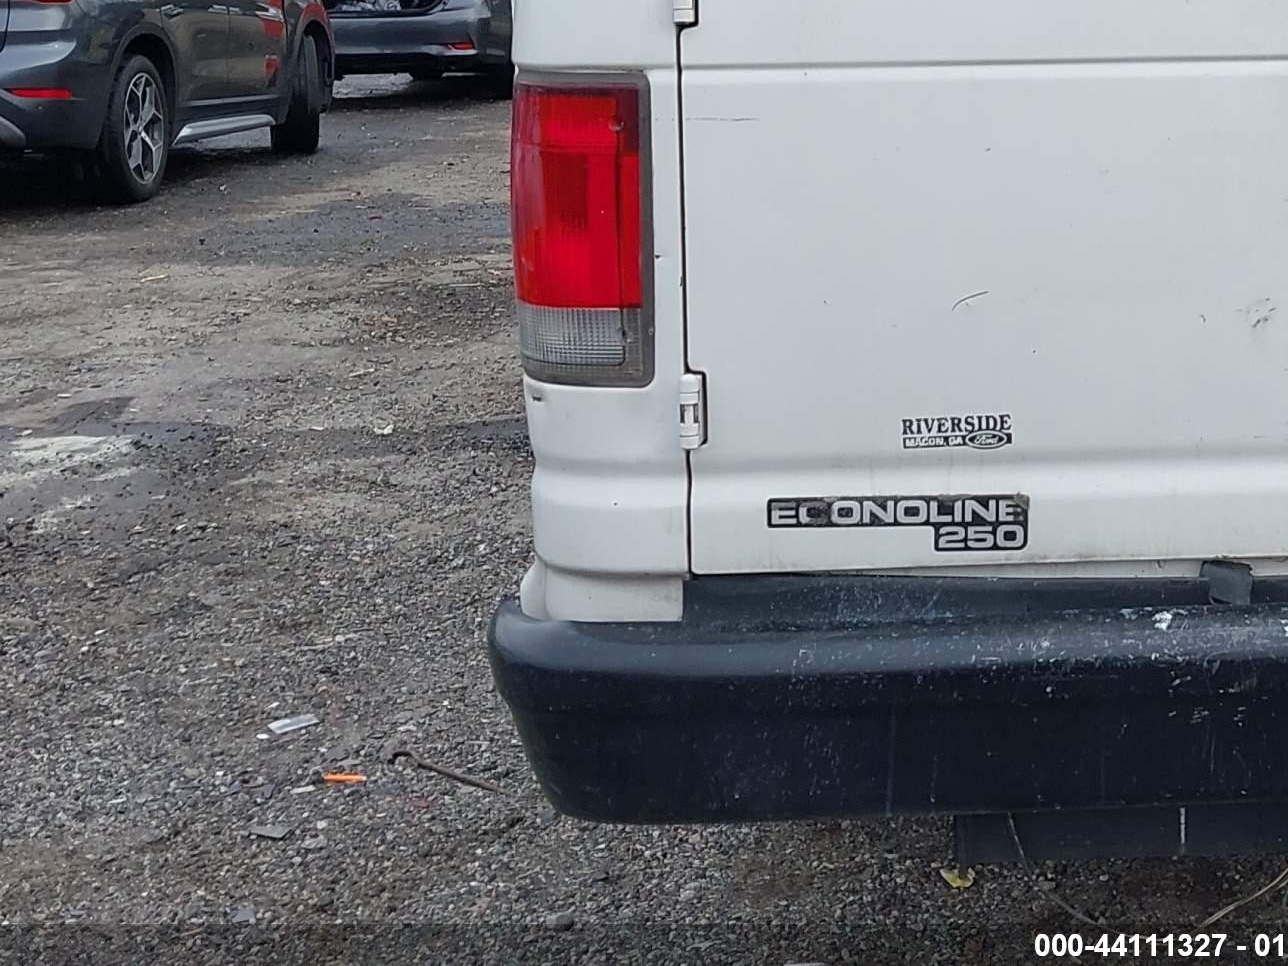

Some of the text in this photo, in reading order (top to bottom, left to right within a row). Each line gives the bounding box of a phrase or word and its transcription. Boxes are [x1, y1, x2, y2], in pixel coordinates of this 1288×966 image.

[901, 414, 1013, 435] RIVERSIDE
[770, 498, 1026, 526] ECONOLINE
[938, 525, 1025, 549] 250
